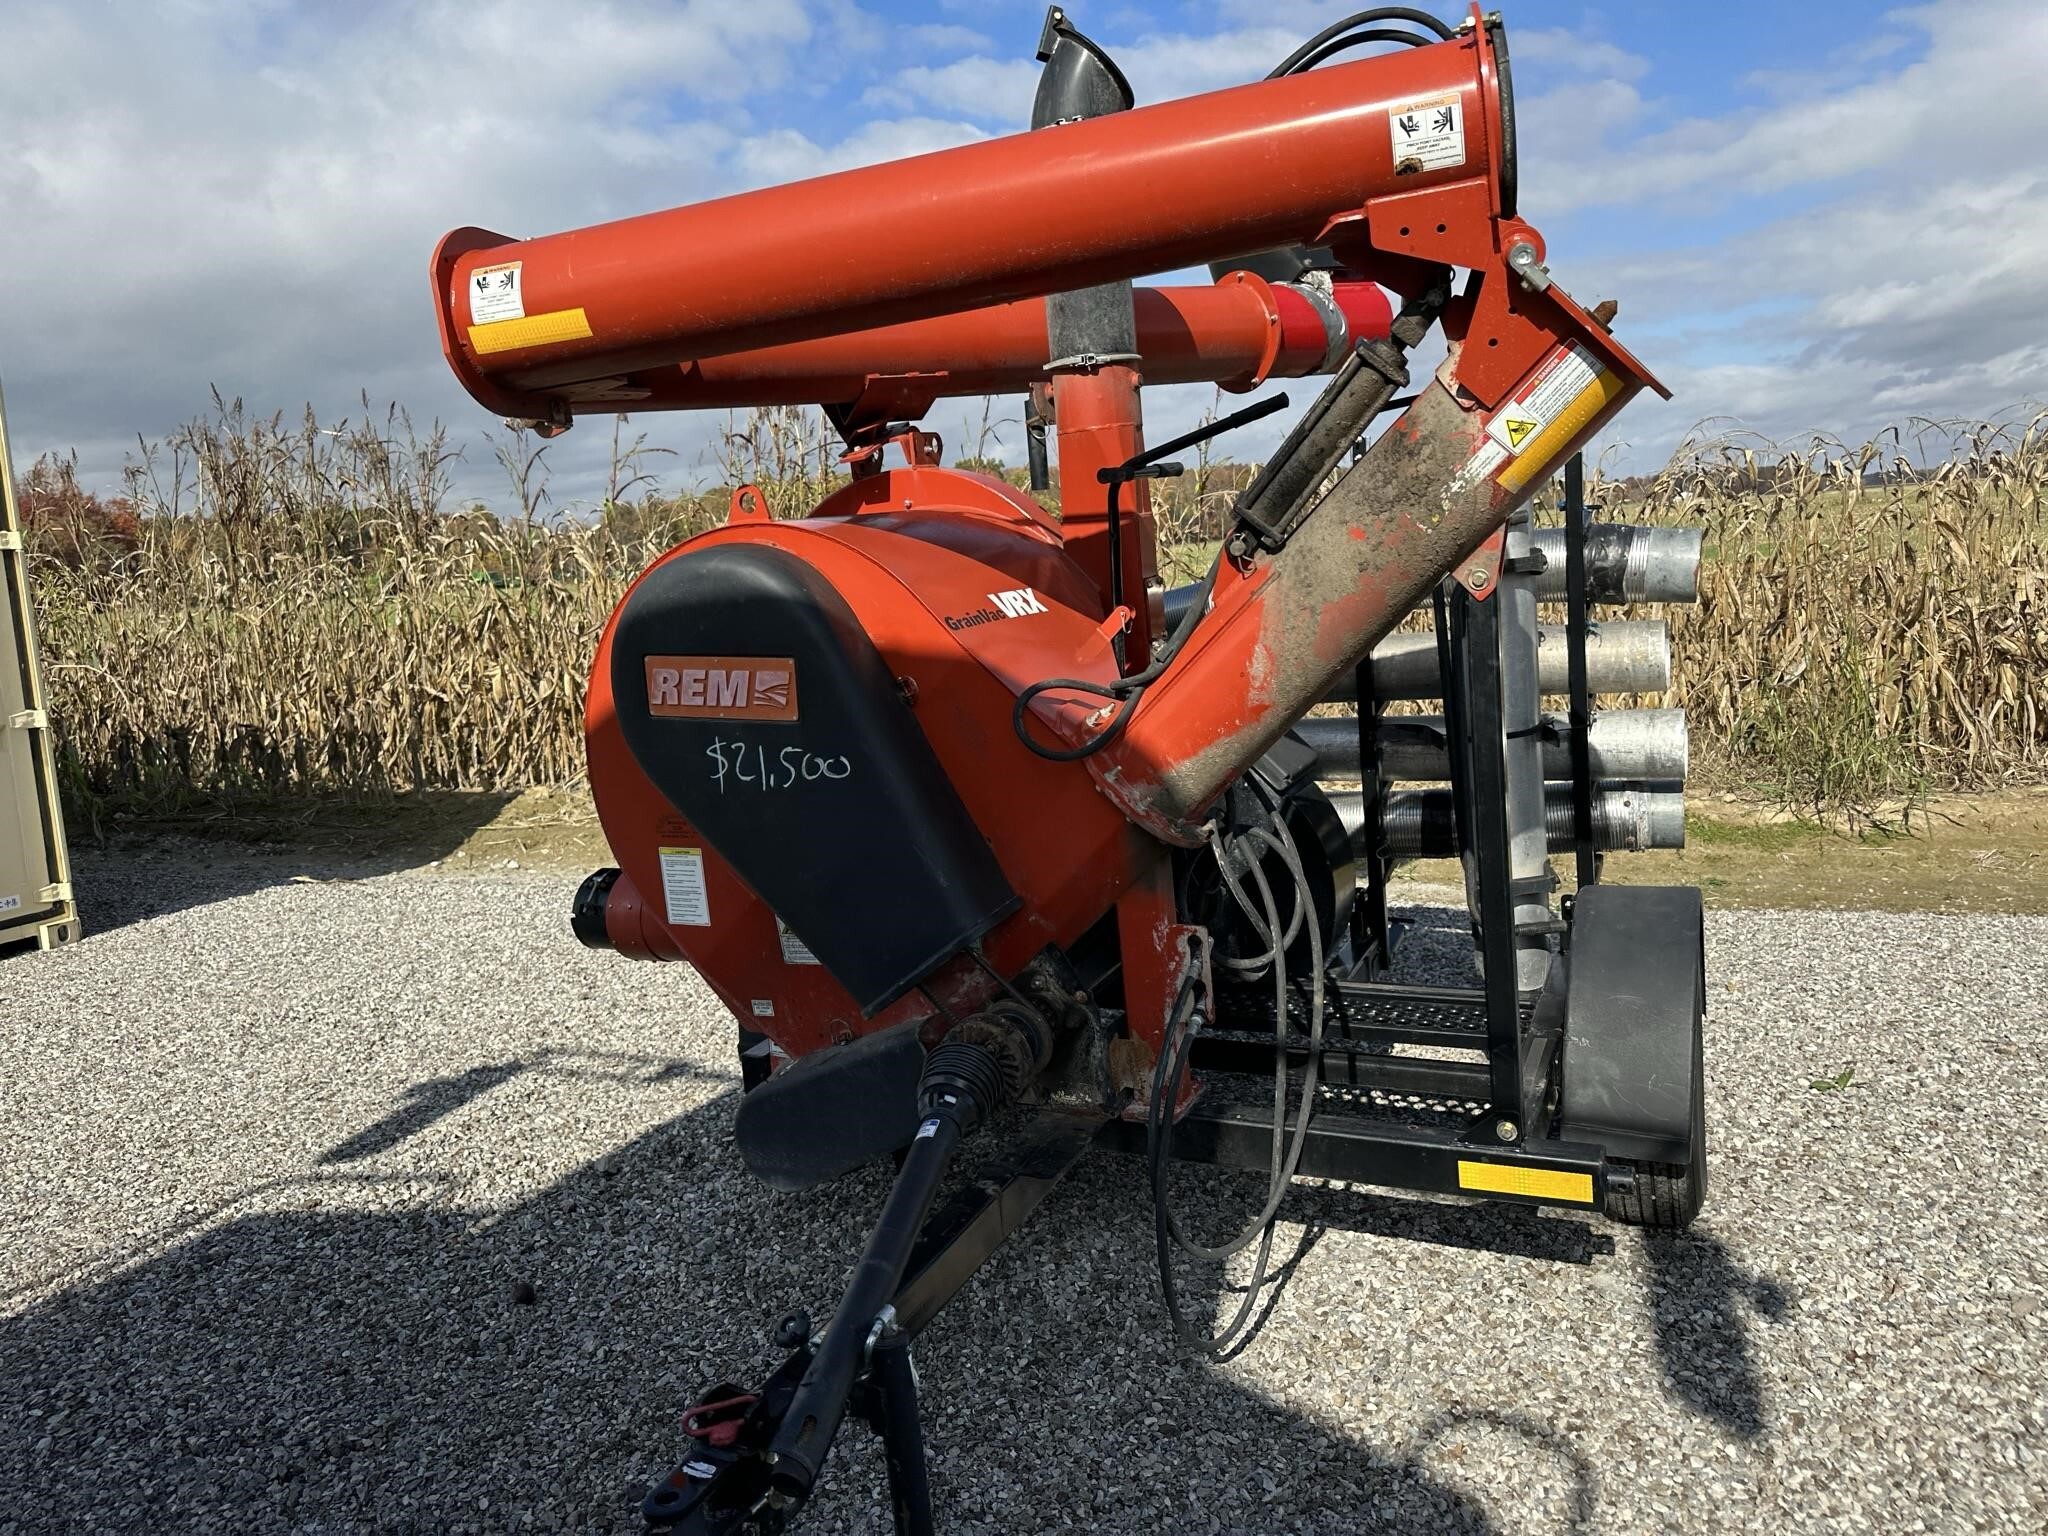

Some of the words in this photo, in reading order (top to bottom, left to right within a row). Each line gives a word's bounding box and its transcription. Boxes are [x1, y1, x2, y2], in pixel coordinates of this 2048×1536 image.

[1414, 99, 1445, 110] WARNING
[1538, 358, 1560, 381] DANGER
[944, 608, 1007, 631] GrainVac
[986, 587, 1049, 618] VRX
[651, 668, 750, 708] REM
[706, 736, 851, 794] $21,500
